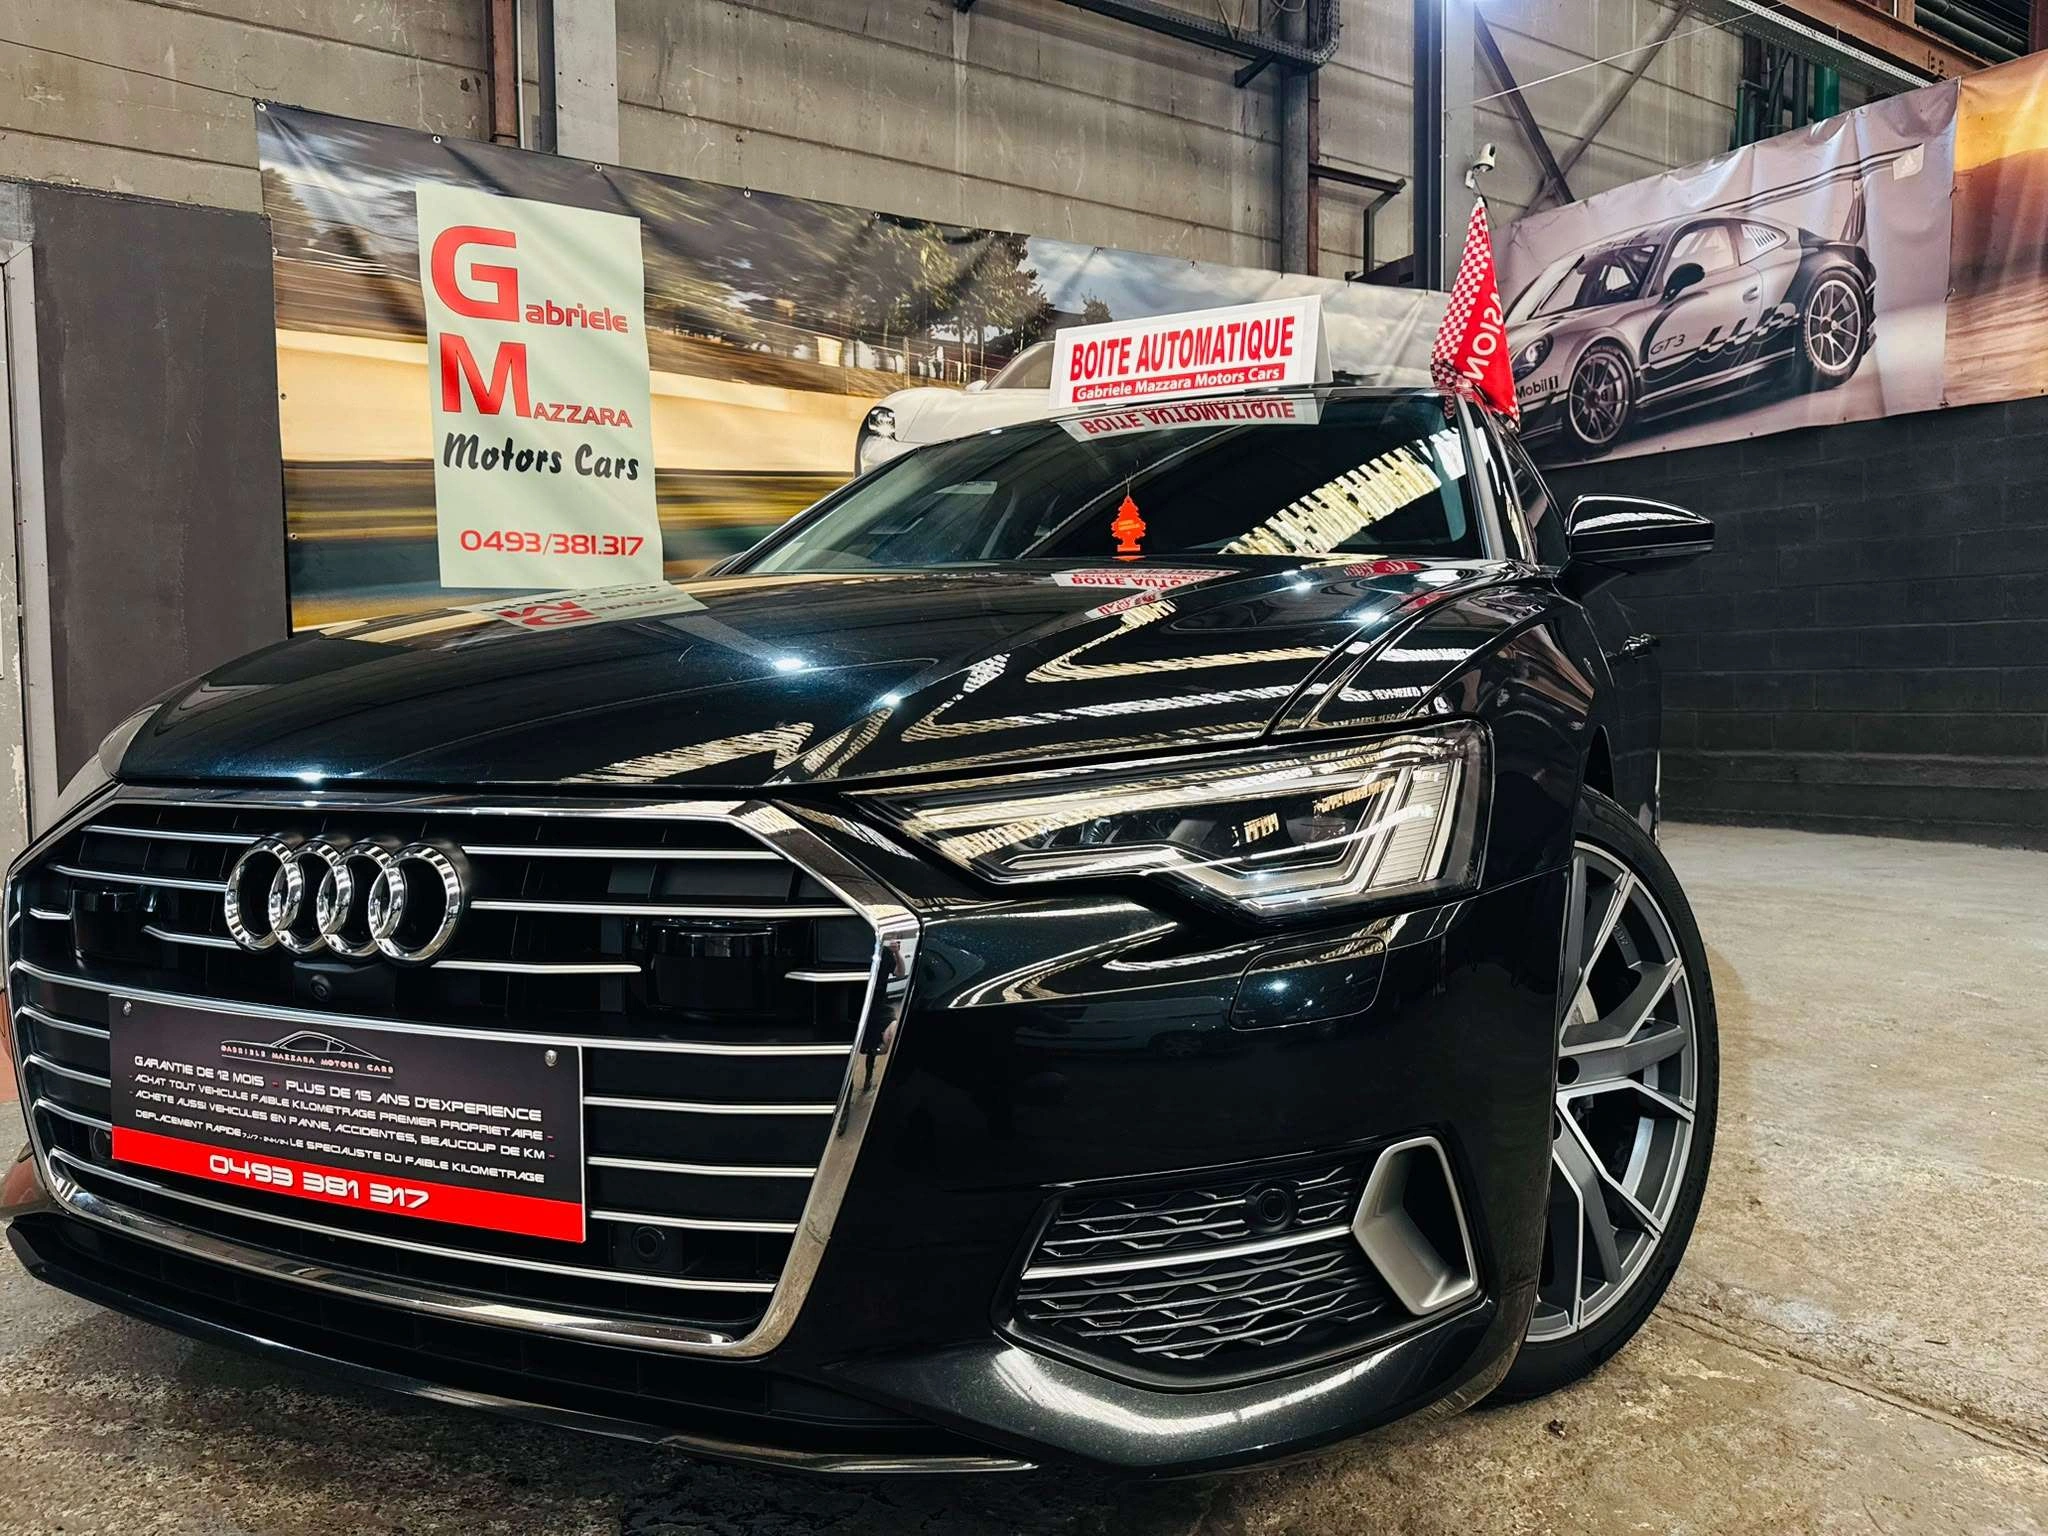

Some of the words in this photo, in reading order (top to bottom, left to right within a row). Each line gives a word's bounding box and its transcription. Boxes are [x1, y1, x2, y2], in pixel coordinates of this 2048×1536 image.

[431, 225, 628, 334] Gabriele
[1070, 336, 1132, 381] BOITE
[1135, 316, 1295, 373] AUTOMATIQUE
[1651, 334, 1685, 356] GT3
[440, 333, 632, 428] MAZZARA
[1076, 379, 1132, 401] Gabriele
[1135, 375, 1191, 394] Mazzara
[1195, 370, 1245, 387] Motors
[1248, 366, 1280, 381] Cars
[443, 432, 562, 476] Motors
[575, 443, 640, 481] Cars
[460, 529, 644, 556] 0493/381.317
[134, 1055, 194, 1076] GARANTIE
[196, 1066, 214, 1079] DE
[217, 1069, 229, 1081] 12
[233, 1072, 265, 1087] MOIS
[286, 1080, 326, 1096] PLUS
[329, 1086, 351, 1100] DE
[355, 1090, 372, 1102] 15
[376, 1093, 411, 1107] ANS
[414, 1096, 542, 1122] D'EXPERIENCE
[135, 1073, 166, 1087] ACHAT
[169, 1079, 196, 1092] TOUT
[198, 1084, 249, 1101] VEHICULE
[250, 1093, 290, 1107] FAIBLE
[292, 1099, 376, 1120] KILOMETRAGE
[379, 1113, 437, 1128] PREMIER
[440, 1119, 544, 1141] PROPRIETAIRE
[135, 1090, 174, 1104] ACHETE
[177, 1098, 207, 1110] AUSSI
[209, 1103, 267, 1121] VEHICULES
[270, 1114, 286, 1125] EN
[289, 1116, 331, 1132] PANNE,
[335, 1124, 417, 1145] ACCIDENTES,
[421, 1134, 496, 1153] BEAUCOUP
[500, 1145, 521, 1157] DE
[523, 1148, 545, 1160] KM
[135, 1109, 203, 1129] DEPLACEMENT
[205, 1123, 242, 1137] RAPIDE
[290, 1138, 304, 1148] LE
[307, 1141, 382, 1161] SPECIALISTE
[385, 1152, 402, 1163] DU
[405, 1156, 449, 1170] FAIBLE
[452, 1162, 545, 1184] KILOMETRAGE
[209, 1154, 294, 1187] 0493
[303, 1171, 360, 1200] 381
[370, 1182, 429, 1209] 317
